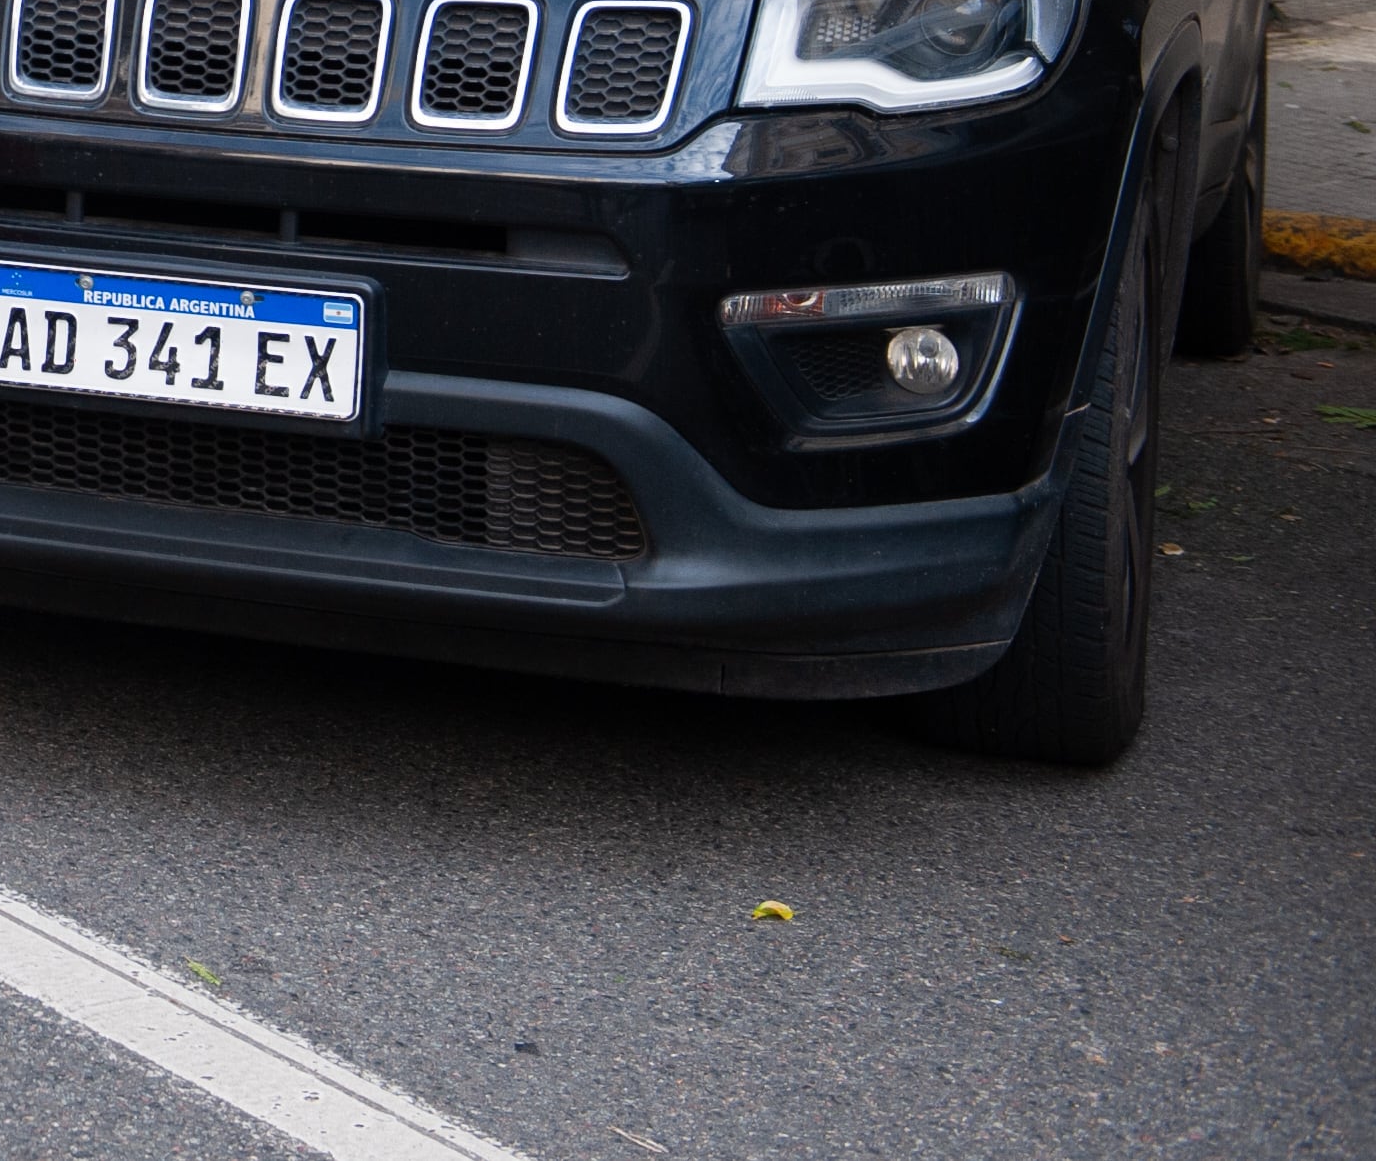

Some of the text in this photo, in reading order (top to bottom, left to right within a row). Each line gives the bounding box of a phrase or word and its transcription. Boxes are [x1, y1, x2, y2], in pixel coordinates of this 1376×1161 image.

[82, 289, 256, 319] REPUBLICA ARGENTINA
[104, 316, 226, 391] 341
[254, 330, 337, 403] EX
